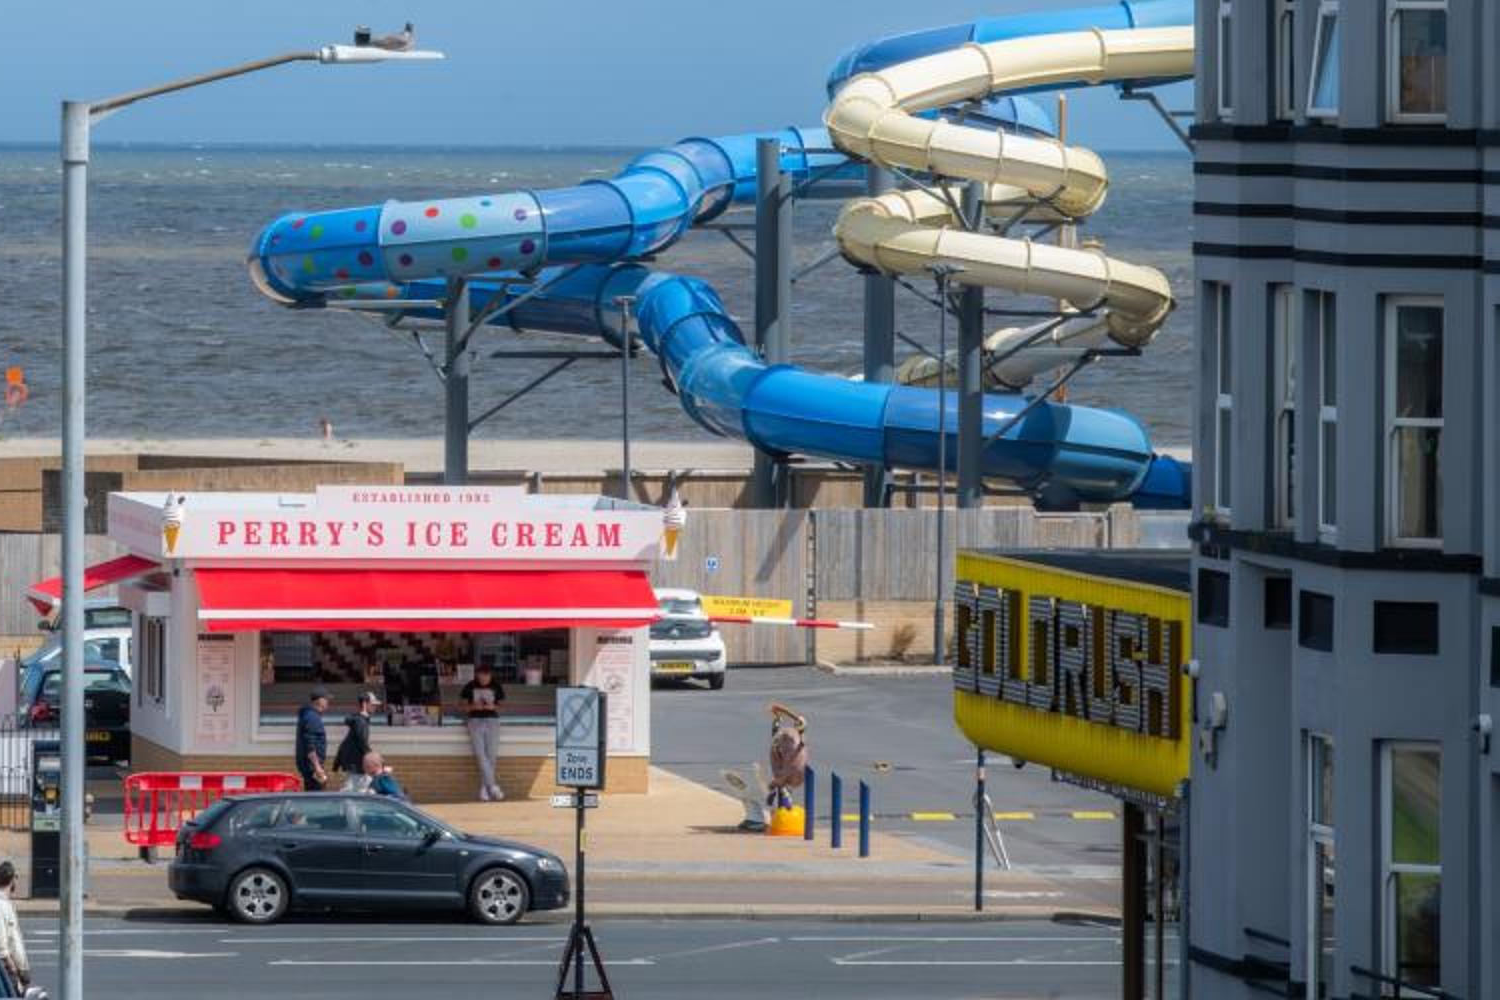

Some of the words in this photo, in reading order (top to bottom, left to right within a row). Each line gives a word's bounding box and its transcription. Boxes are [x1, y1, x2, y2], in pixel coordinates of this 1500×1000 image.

[353, 493, 451, 504] ESTABLISHED
[217, 521, 385, 547] PERRY'S
[407, 522, 468, 547] ICE
[491, 522, 622, 548] CREAM
[561, 767, 594, 780] ENDS
